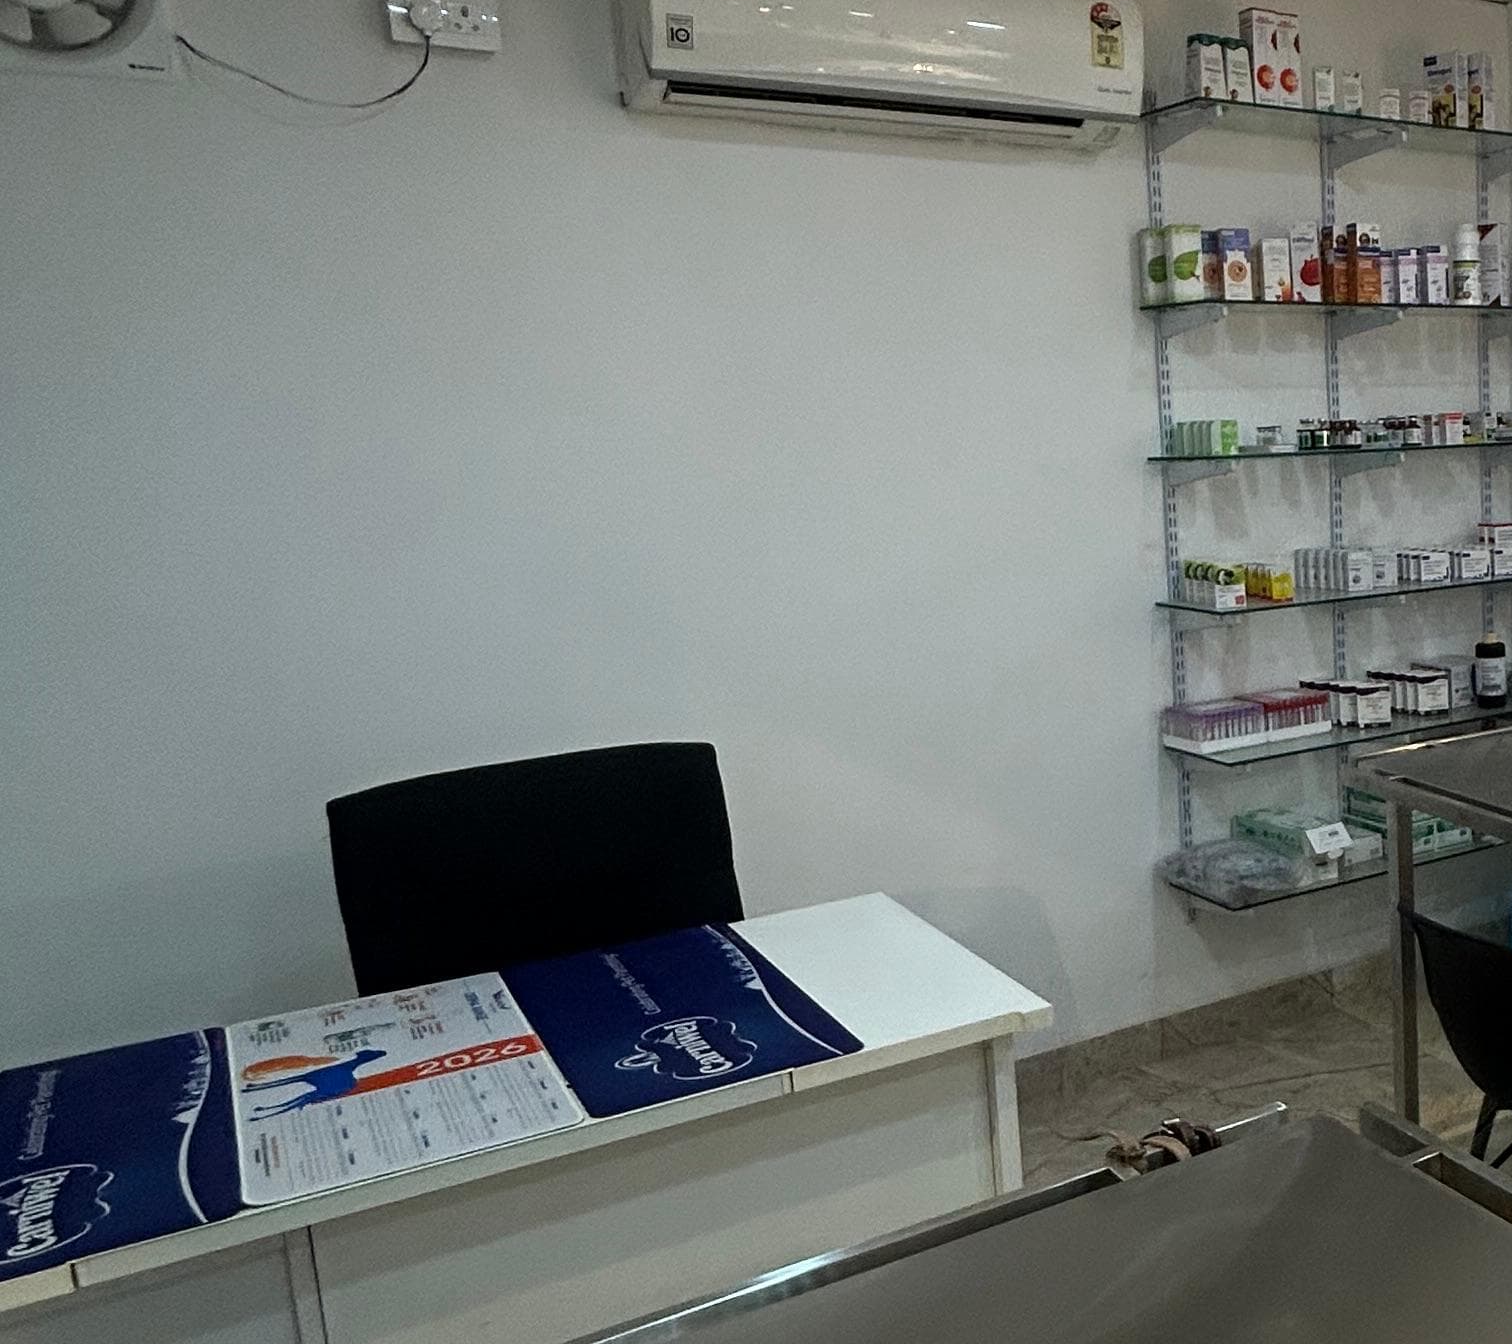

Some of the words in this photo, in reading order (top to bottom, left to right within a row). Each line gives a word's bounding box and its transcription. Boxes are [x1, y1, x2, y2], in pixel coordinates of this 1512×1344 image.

[415, 1041, 528, 1076] 2026
[664, 1020, 733, 1073] Carniwel
[7, 1169, 71, 1256] Carniwel
